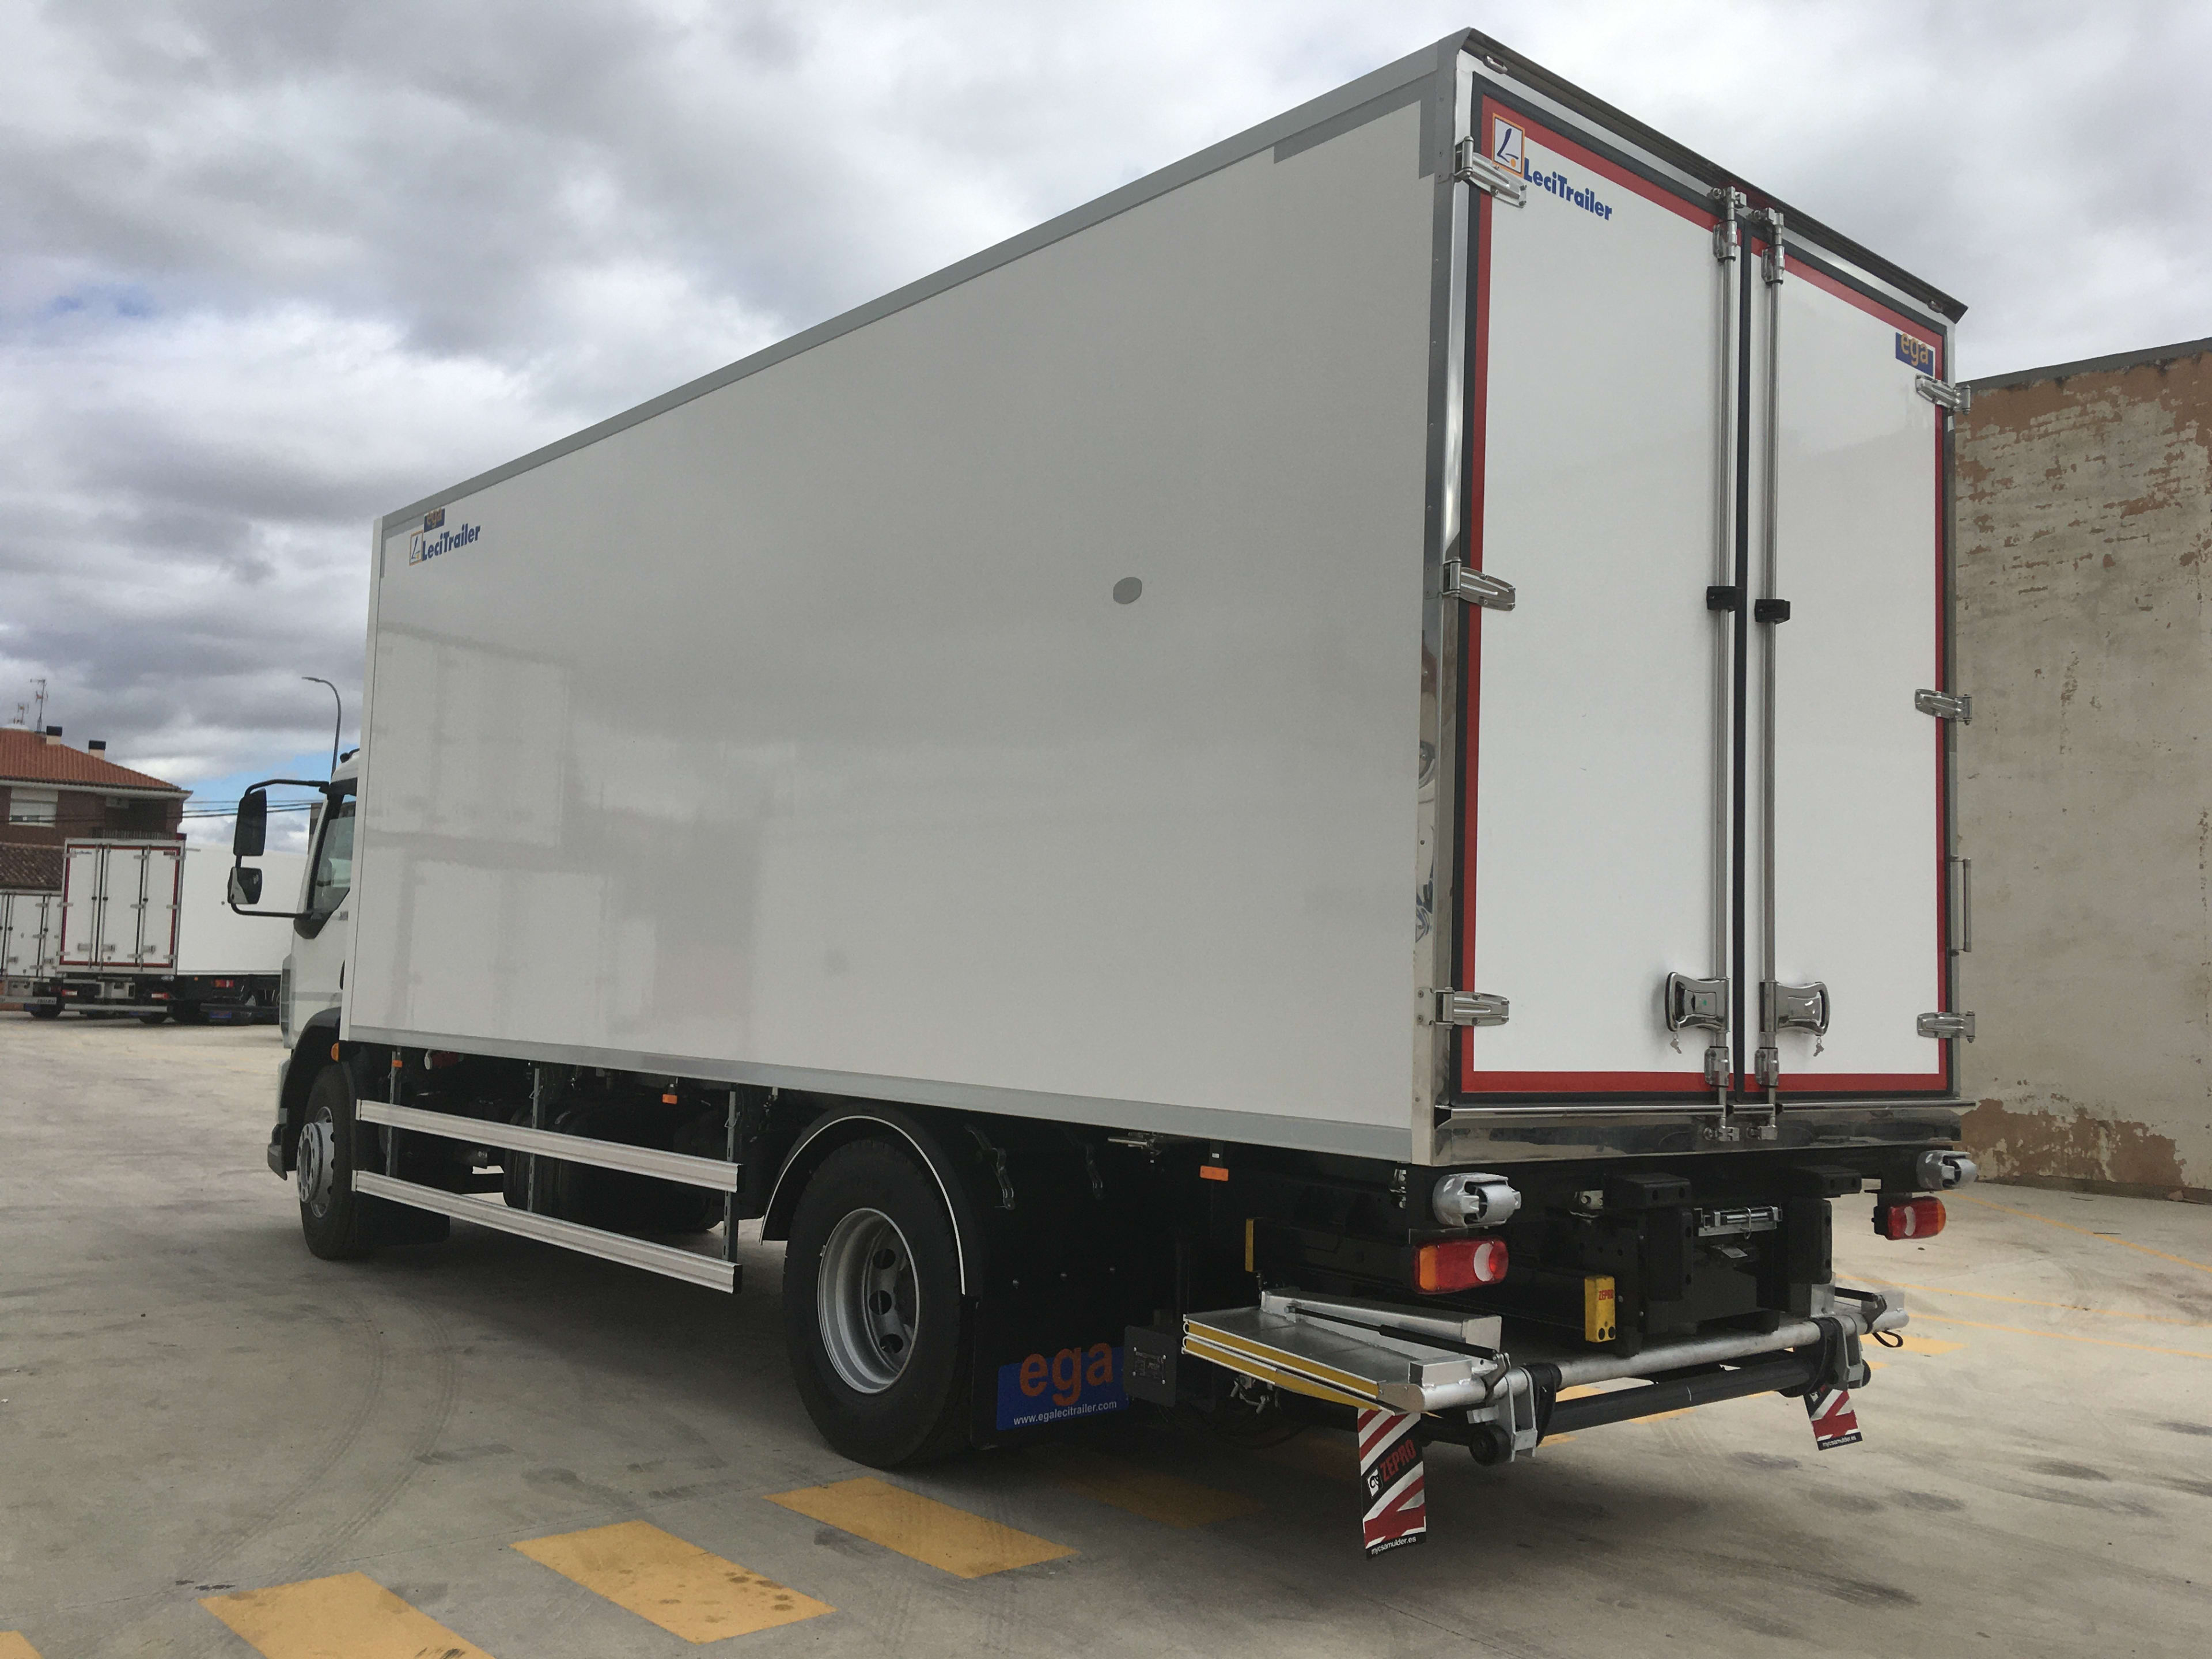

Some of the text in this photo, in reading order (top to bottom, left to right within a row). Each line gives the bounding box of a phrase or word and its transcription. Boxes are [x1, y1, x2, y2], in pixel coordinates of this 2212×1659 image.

[1524, 157, 1612, 221] LeciTrailer
[1901, 333, 1929, 366] ega
[422, 523, 481, 561] LeciTrailer
[1020, 1343, 1113, 1406] ega
[1013, 1400, 1117, 1426] www.egalecitrailer.com
[1380, 1439, 1416, 1482] ZEPRO
